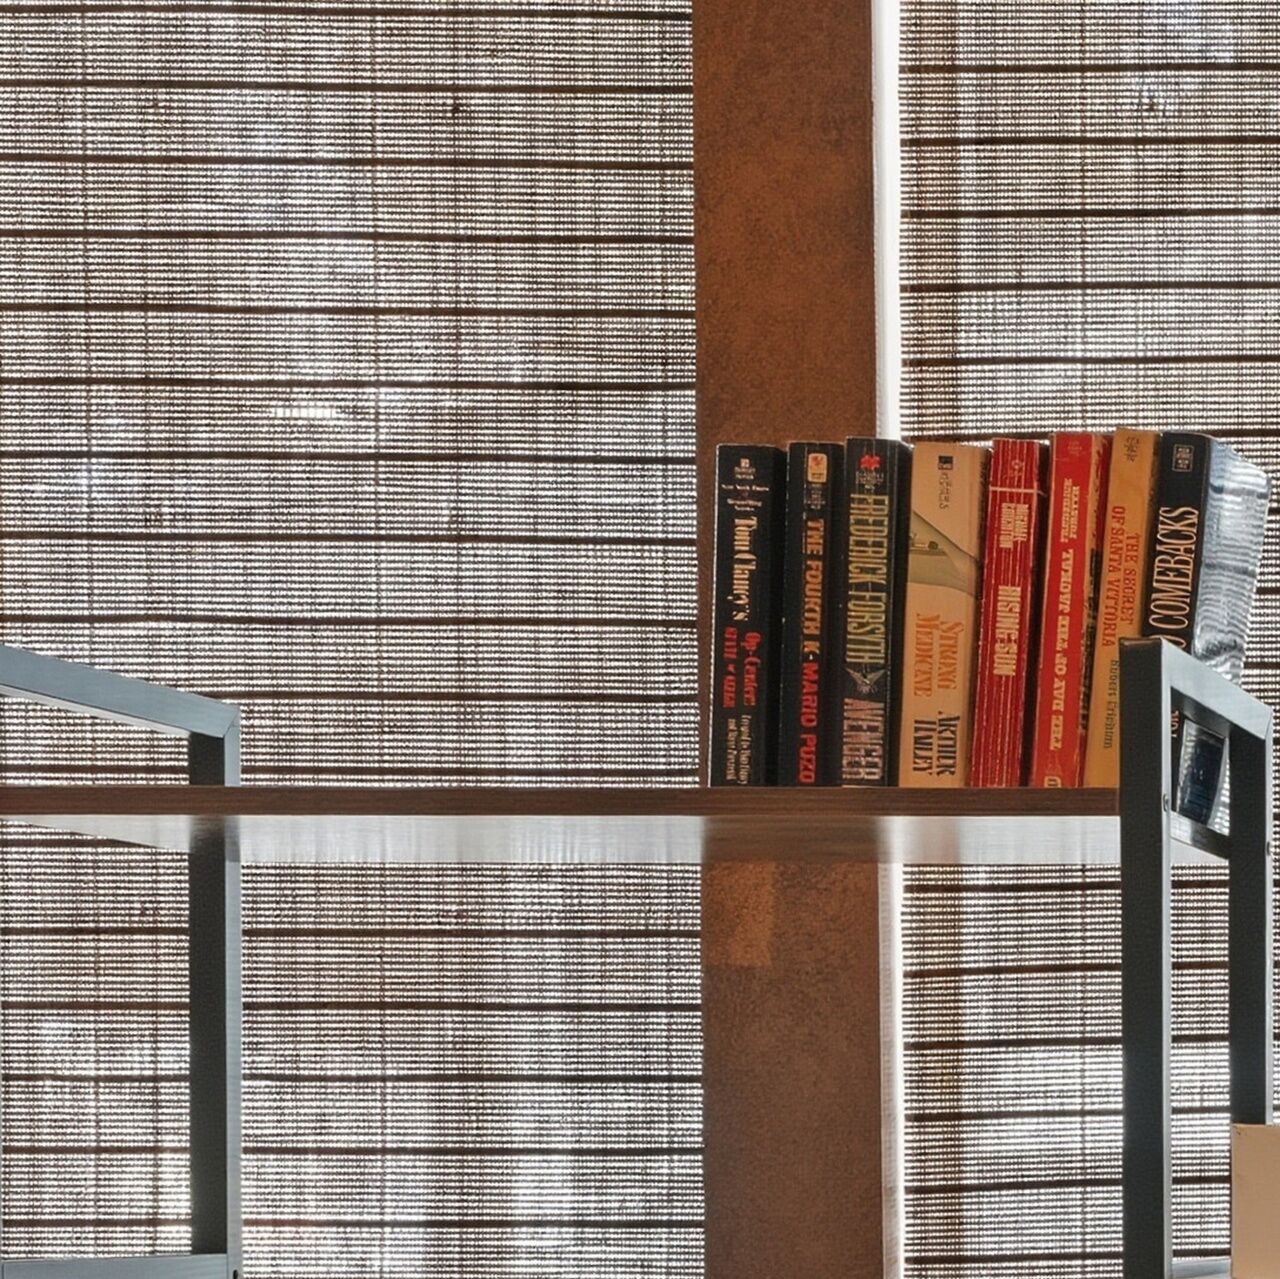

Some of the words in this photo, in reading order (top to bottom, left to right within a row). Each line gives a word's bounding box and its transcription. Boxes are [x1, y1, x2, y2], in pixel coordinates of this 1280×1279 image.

[733, 517, 757, 553] Tom
[806, 519, 825, 555] THE
[848, 493, 889, 585] FREDERICK
[1111, 506, 1126, 526] OF
[1106, 527, 1124, 574] SANTA
[1124, 532, 1141, 563] THE
[1148, 507, 1199, 626] COMEBACKS
[803, 561, 824, 633] FOURTH
[1057, 548, 1074, 614] JACKAL
[1119, 569, 1138, 626] SECRET
[845, 590, 886, 664] FORSYTH
[995, 585, 1022, 639] RISING
[1055, 615, 1069, 652] THE
[1101, 579, 1121, 648] VITTORIA
[803, 640, 819, 653] K
[913, 613, 940, 697] MEDICINE
[936, 621, 965, 690] STRONG
[993, 642, 1018, 677] SUN
[1054, 653, 1067, 675] OF
[801, 663, 819, 727] MARIO
[1052, 677, 1066, 710] DAY
[842, 697, 886, 781] AVENGER
[1050, 714, 1064, 750] THE
[799, 735, 818, 784] PUZO
